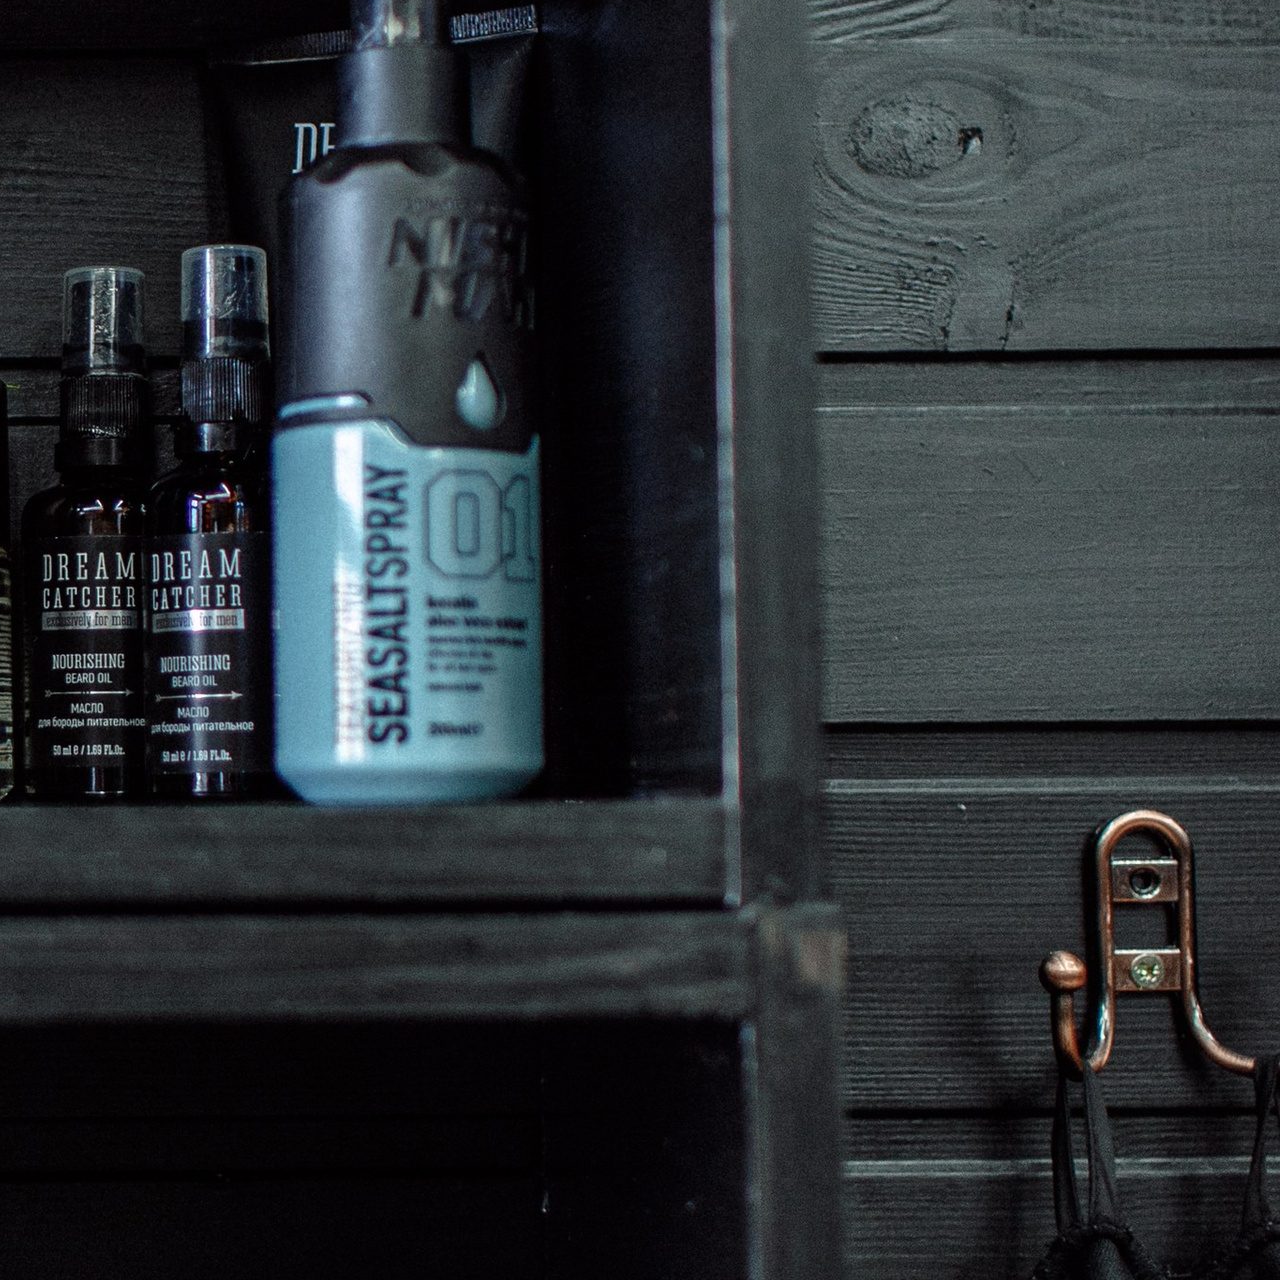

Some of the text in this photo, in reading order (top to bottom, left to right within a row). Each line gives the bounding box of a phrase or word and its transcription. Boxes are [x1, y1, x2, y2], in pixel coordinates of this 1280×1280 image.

[292, 122, 337, 174] DE
[423, 470, 536, 583] 01
[42, 552, 136, 582] DREAM
[151, 548, 242, 583] DREAM
[42, 586, 136, 609] CATCHER
[152, 584, 242, 611] CATCHER
[365, 464, 409, 744] SEASALTSPRAY
[46, 611, 132, 628] exclusively for men
[215, 614, 238, 627] men
[52, 653, 125, 669] NOURISHING
[160, 654, 231, 673] NOURISHING
[65, 672, 112, 684] BEARD OIL
[172, 675, 218, 687] BEARD OIL
[70, 702, 104, 715] МАСЛО
[177, 706, 210, 718] МАСЛО
[52, 717, 85, 729] бороды
[86, 718, 145, 727] питательное
[161, 722, 191, 734] бороды
[192, 720, 254, 732] питательное
[53, 745, 61, 756] 50
[62, 745, 72, 756] ml
[86, 745, 102, 756] 1.69
